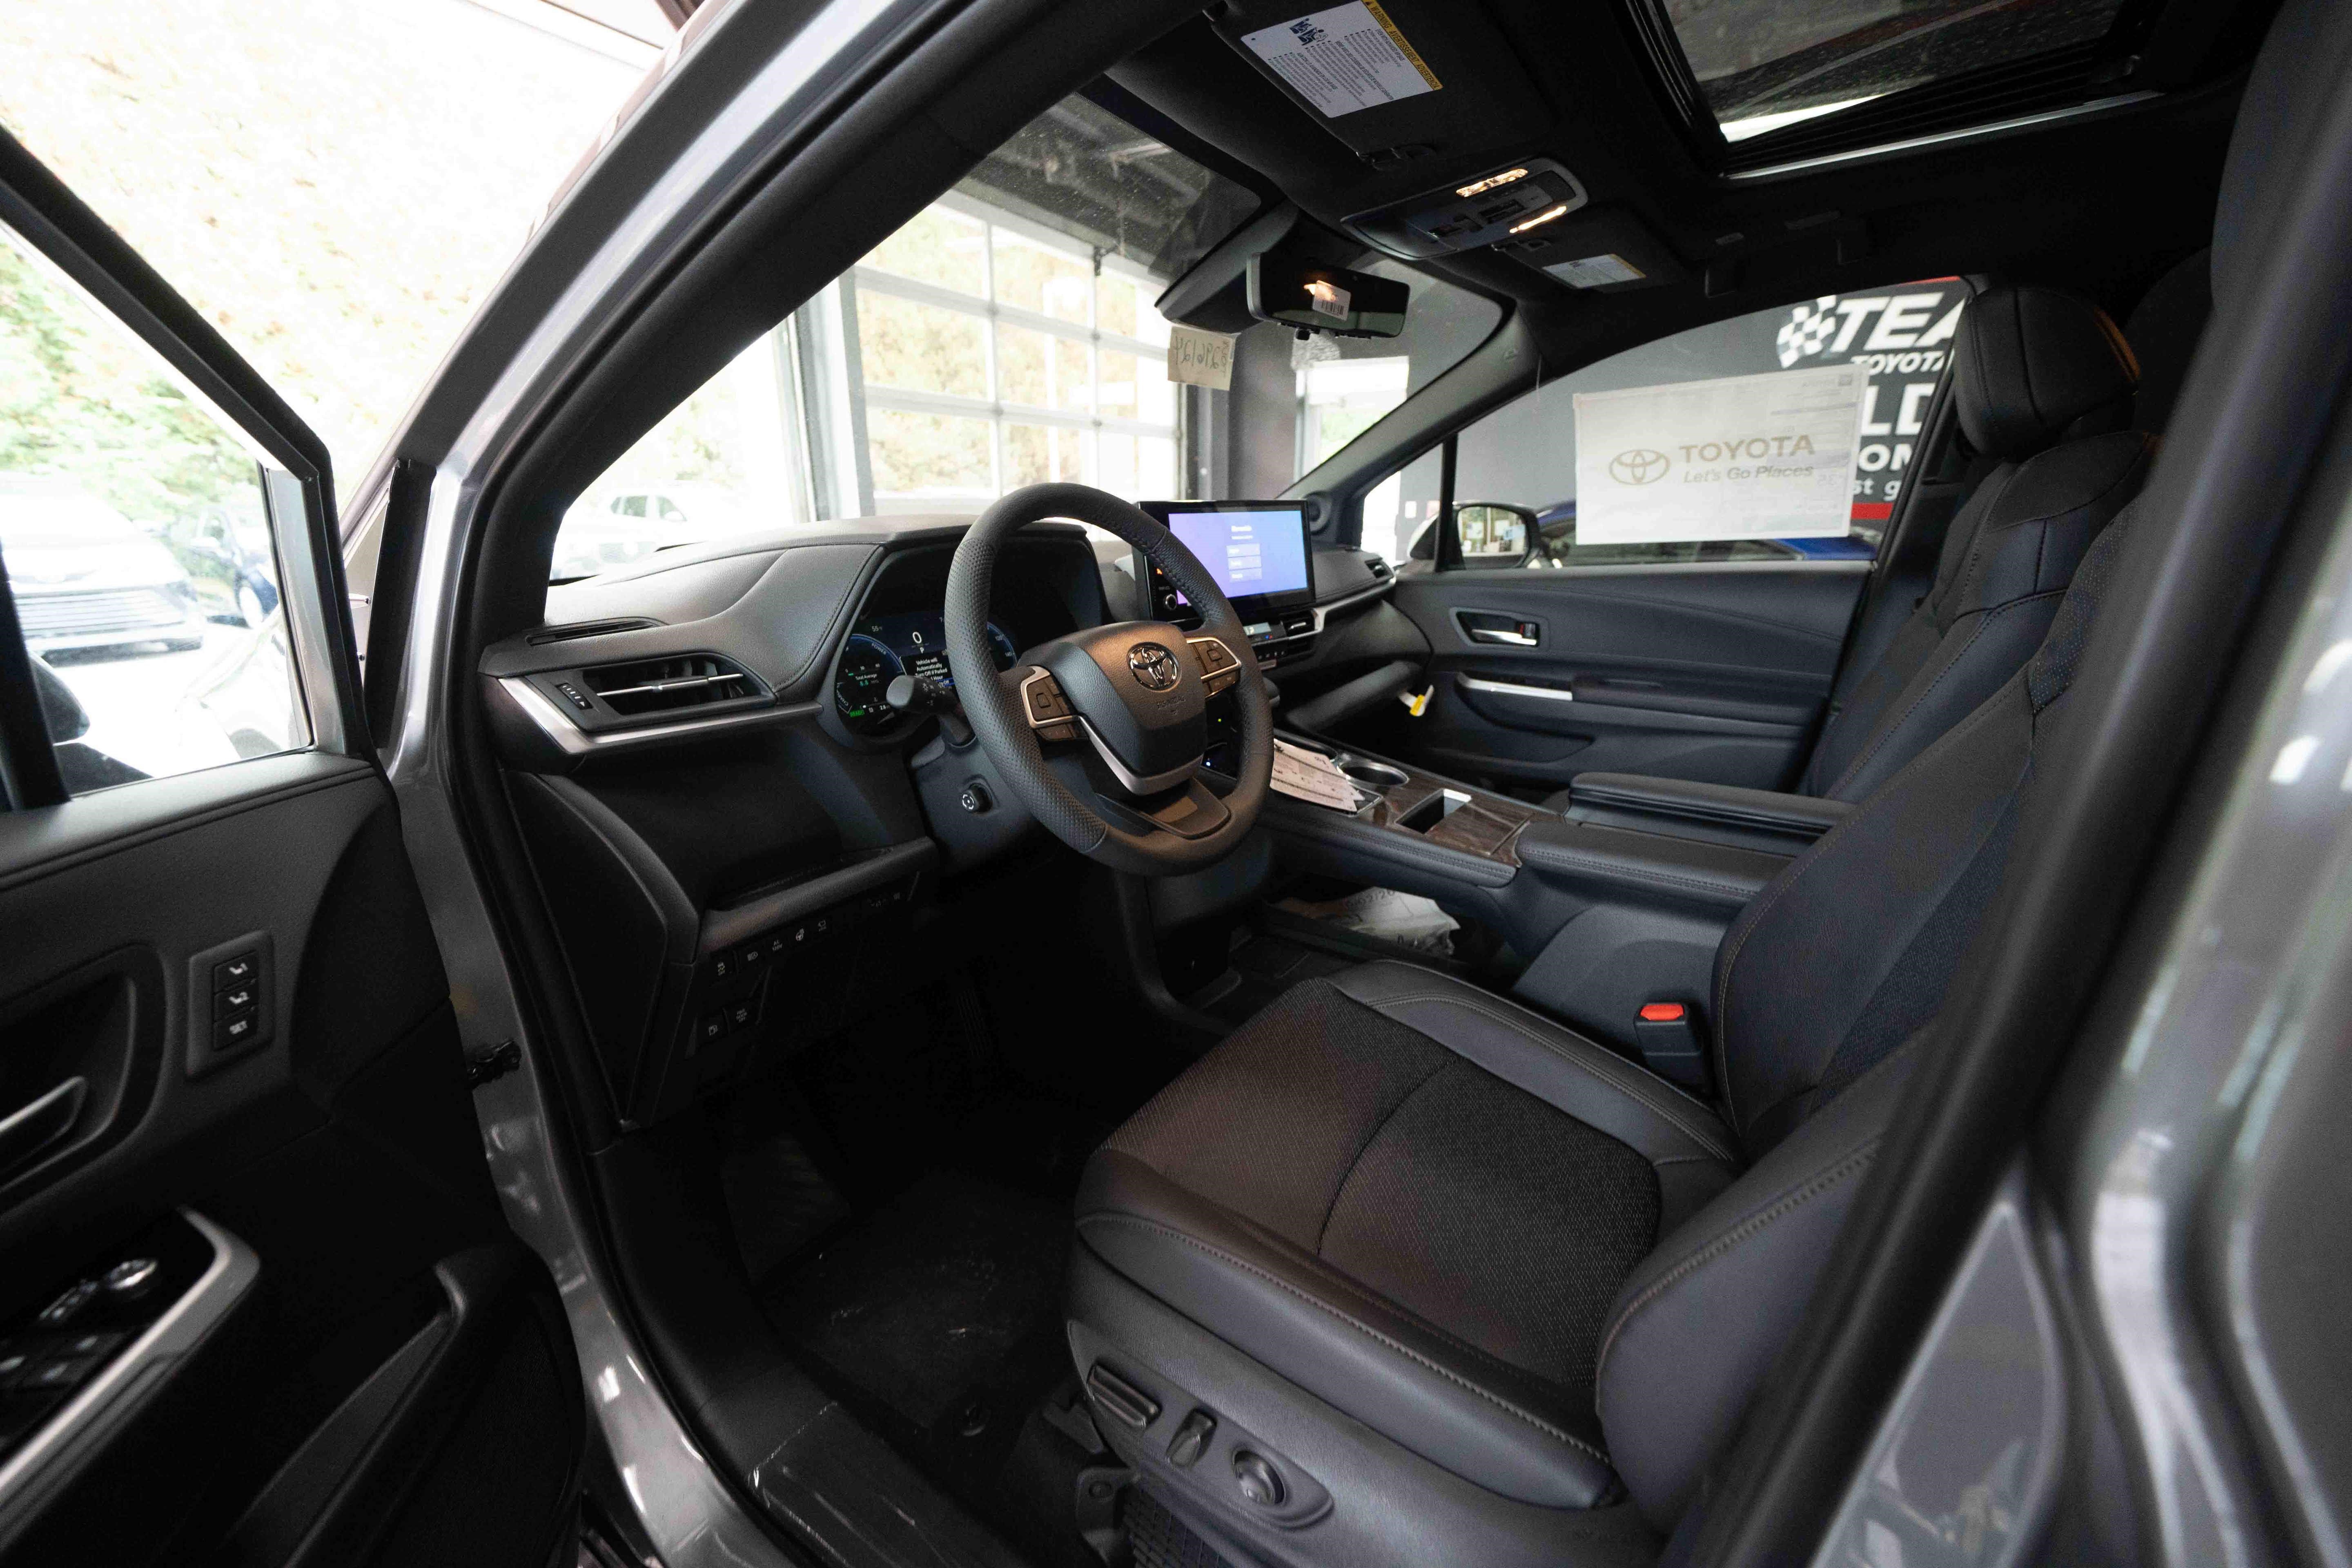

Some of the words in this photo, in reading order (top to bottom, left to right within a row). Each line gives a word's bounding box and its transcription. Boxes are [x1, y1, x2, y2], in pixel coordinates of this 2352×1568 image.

[1371, 6, 1392, 29] WARNING
[1389, 29, 1419, 62] AVERTISSEMENT
[1417, 64, 1440, 89] ADVERTENCIA
[1679, 434, 1816, 463] TOYOTA
[1684, 468, 1721, 483] Let's
[1727, 467, 1751, 480] Go
[1755, 465, 1814, 479] Places
[912, 631, 922, 644] 0
[871, 642, 886, 655] POWER
[916, 663, 942, 672] Automatically
